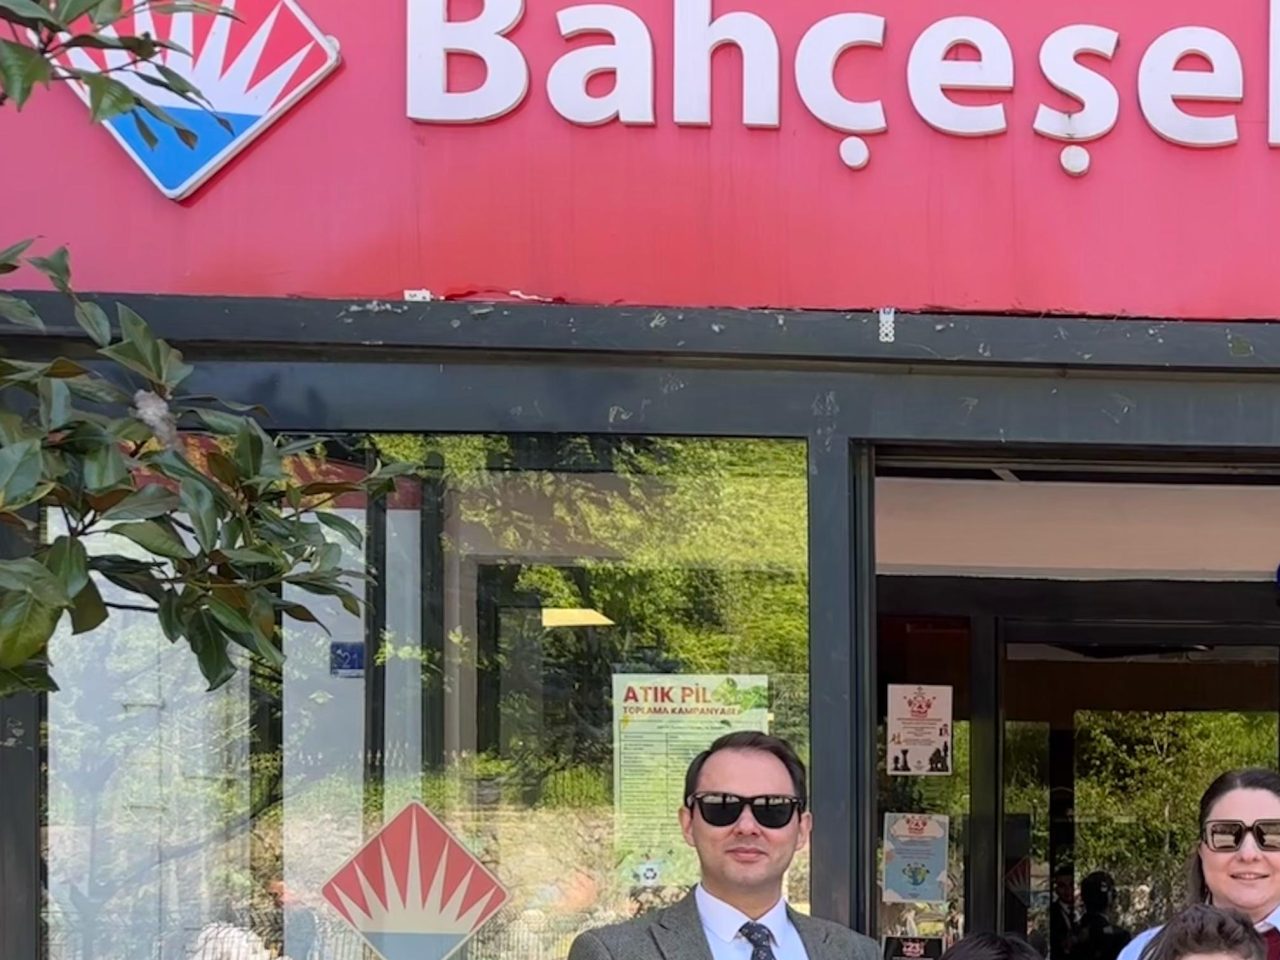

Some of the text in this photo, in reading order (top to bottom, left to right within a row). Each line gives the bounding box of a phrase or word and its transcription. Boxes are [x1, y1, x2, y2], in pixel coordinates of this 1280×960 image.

[623, 683, 712, 703] ATIK PİL
[623, 707, 669, 715] TOPLAMA
